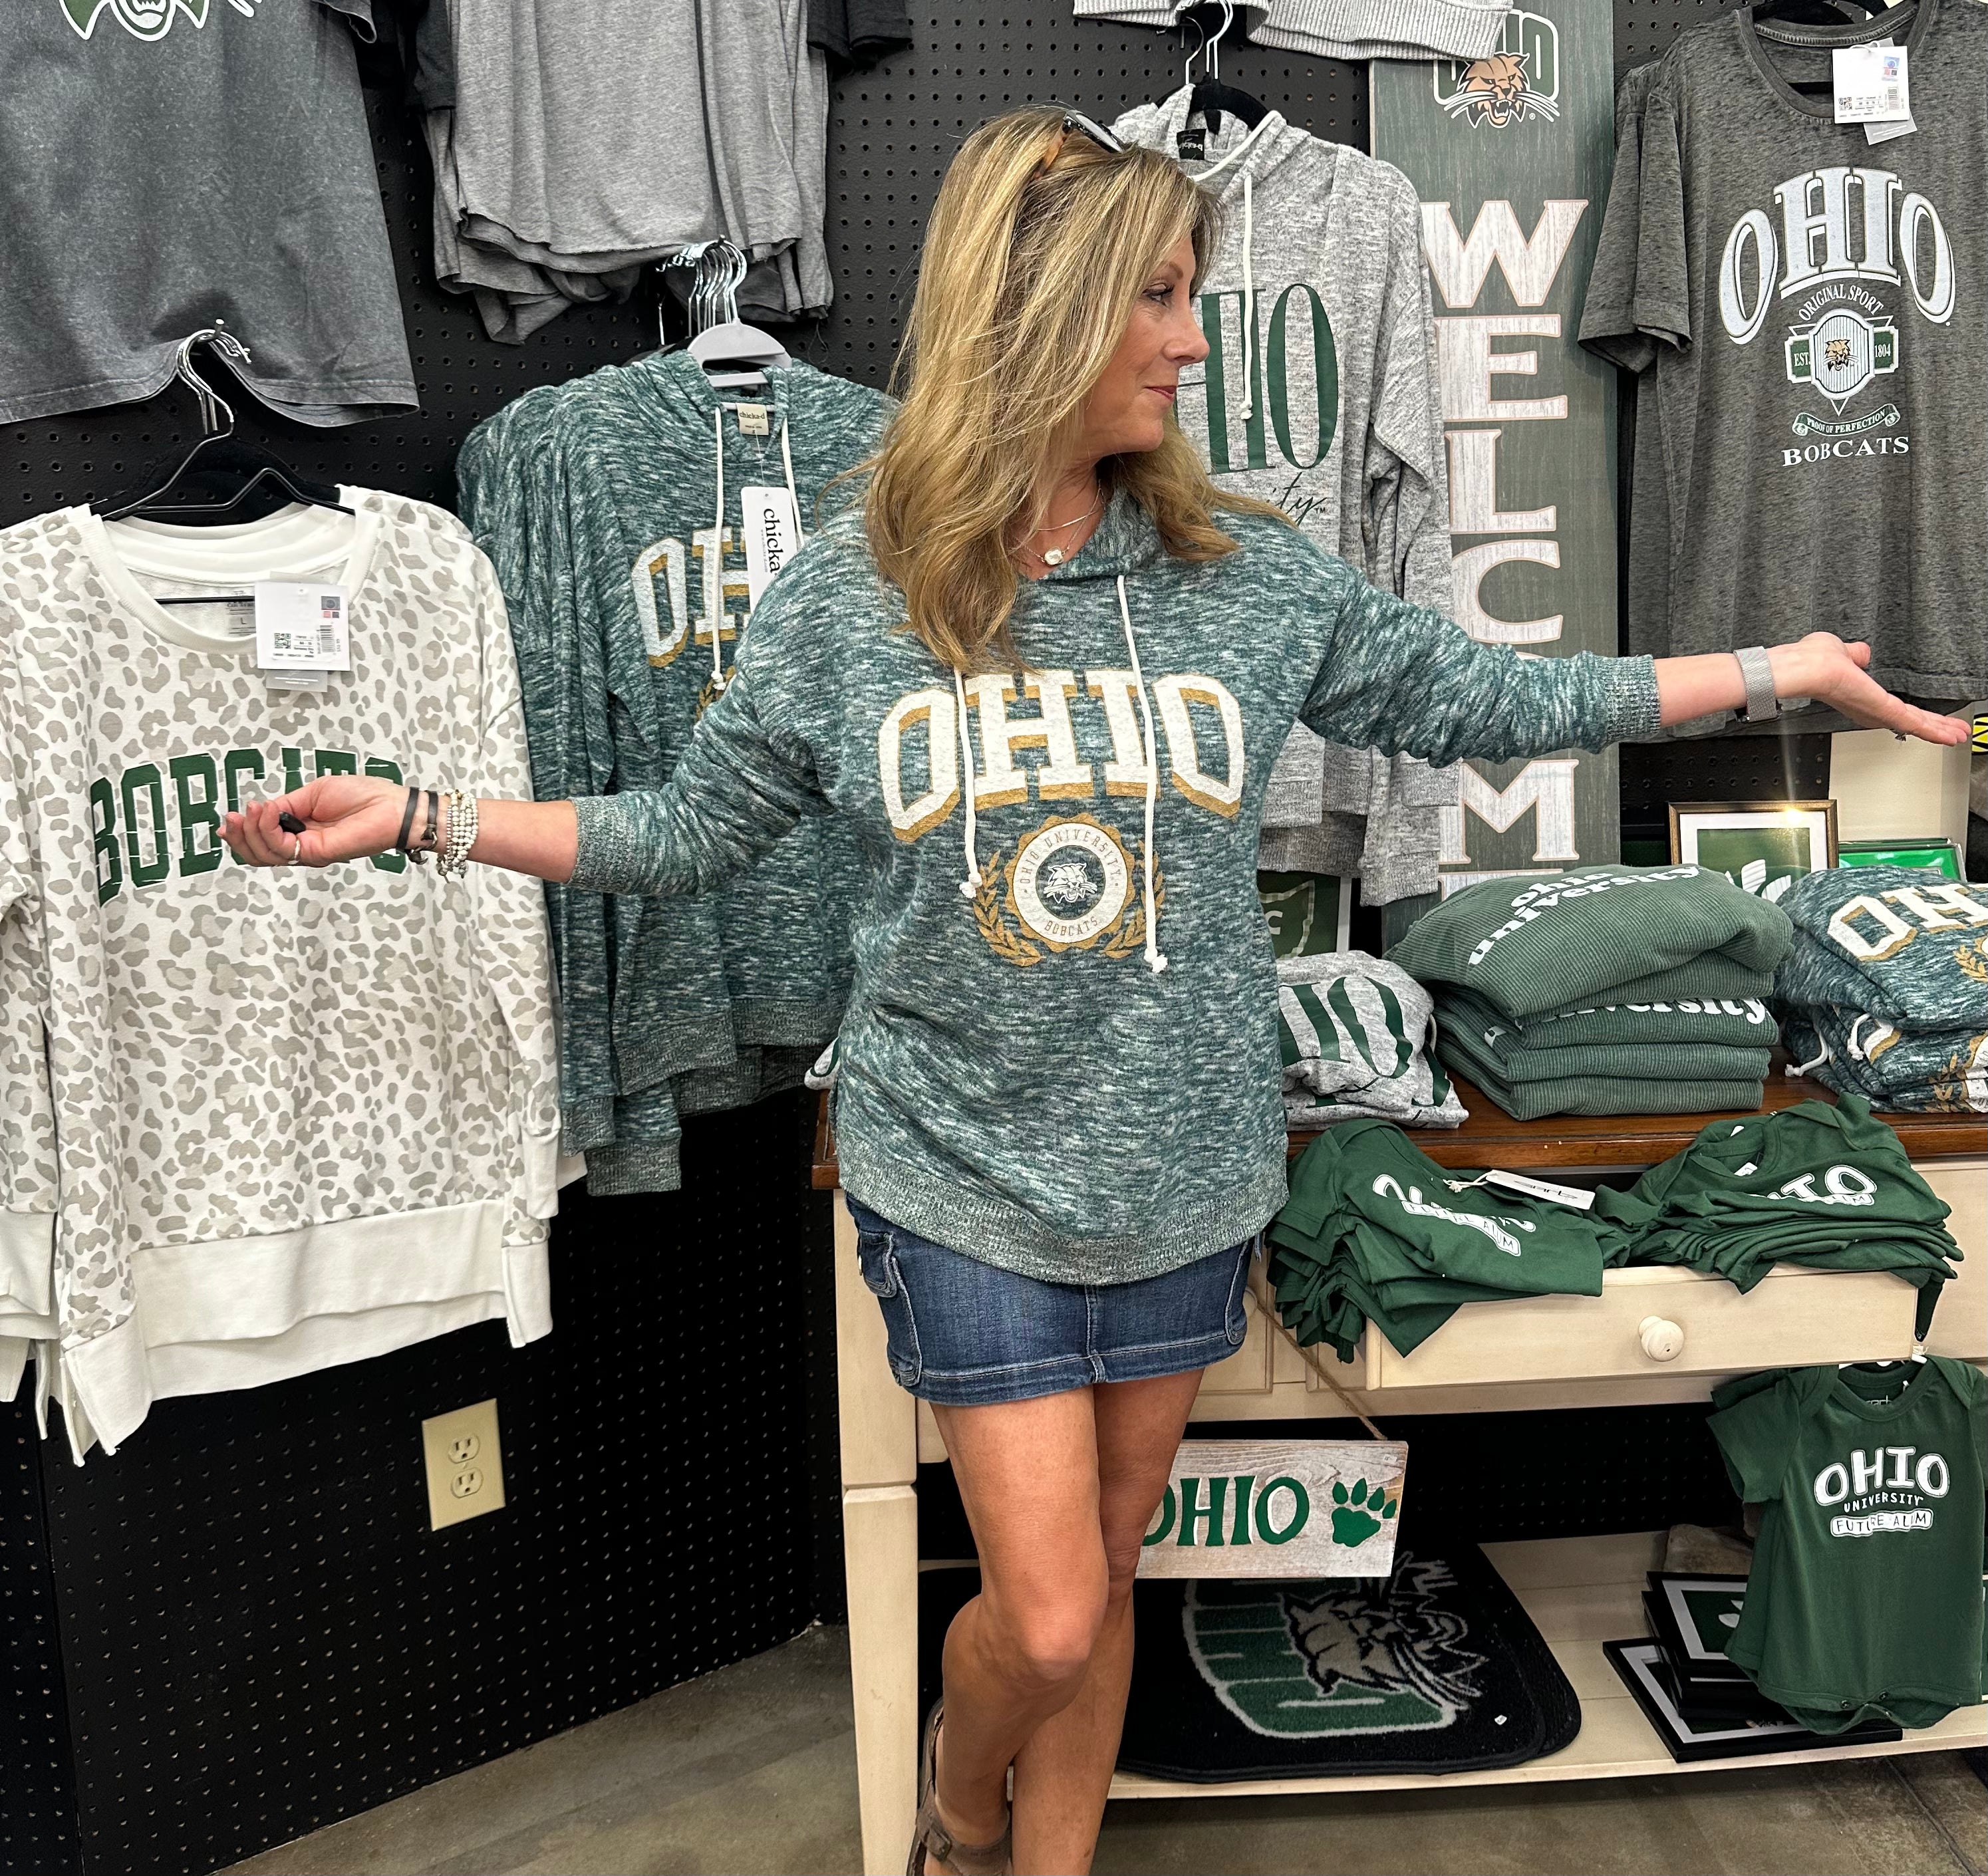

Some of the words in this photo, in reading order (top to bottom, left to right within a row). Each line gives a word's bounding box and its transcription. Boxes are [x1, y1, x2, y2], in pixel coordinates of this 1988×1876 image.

[1719, 166, 1956, 345] OHIO
[1798, 284, 1846, 321] ORIGINAL
[1848, 285, 1884, 315] SPORT
[1874, 344, 1891, 358] 1804
[1807, 417, 1826, 432] PROOF
[1826, 424, 1834, 434] OF
[1835, 410, 1885, 434] PERFECTION
[1781, 436, 1909, 467] BOBCATS
[764, 508, 783, 576] chicka
[1421, 200, 1588, 899] WELCM
[877, 669, 1245, 843] OHIO
[1020, 850, 1040, 884] OHIO
[1044, 829, 1121, 876] UNIVERSITY
[1510, 872, 1613, 907] ohio
[1044, 916, 1099, 936] BOBCATS
[1467, 866, 1699, 965] university
[1827, 883, 1988, 962] OH
[1483, 1219, 1514, 1250] ALUM
[1814, 1446, 1950, 1506] OHIO
[1844, 1491, 1921, 1513] UNIVERSITY
